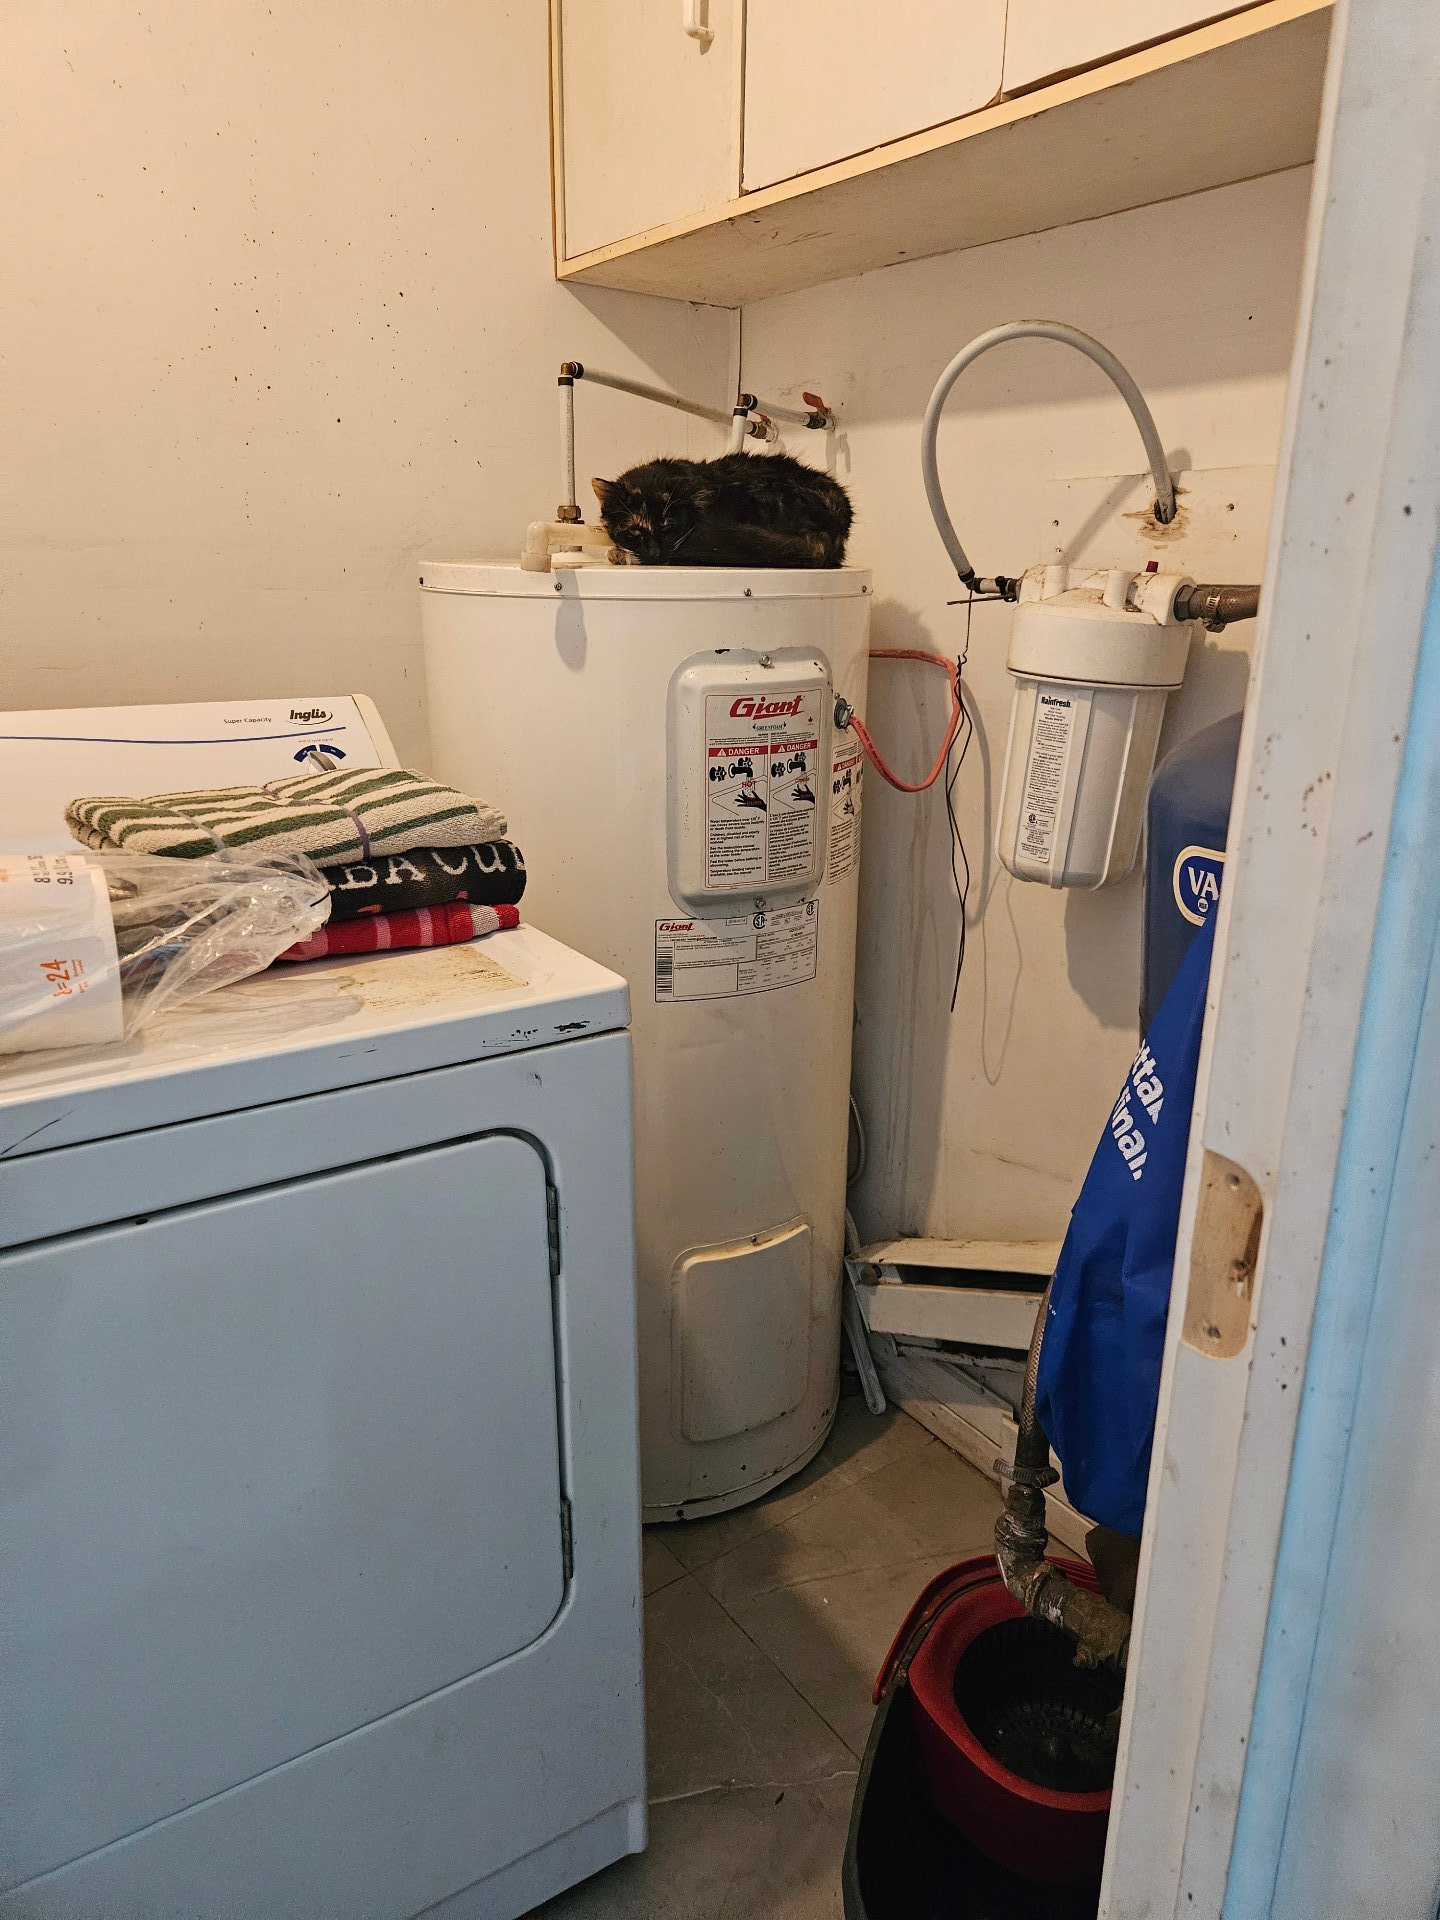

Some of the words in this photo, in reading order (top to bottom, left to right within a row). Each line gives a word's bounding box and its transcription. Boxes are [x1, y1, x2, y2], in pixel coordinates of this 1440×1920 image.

[729, 695, 803, 719] Giant
[1041, 695, 1071, 708] Rainfresh
[290, 709, 327, 721] Inglis
[728, 747, 760, 756] DANGER
[786, 742, 811, 752] DANGER
[659, 922, 694, 933] Giant
